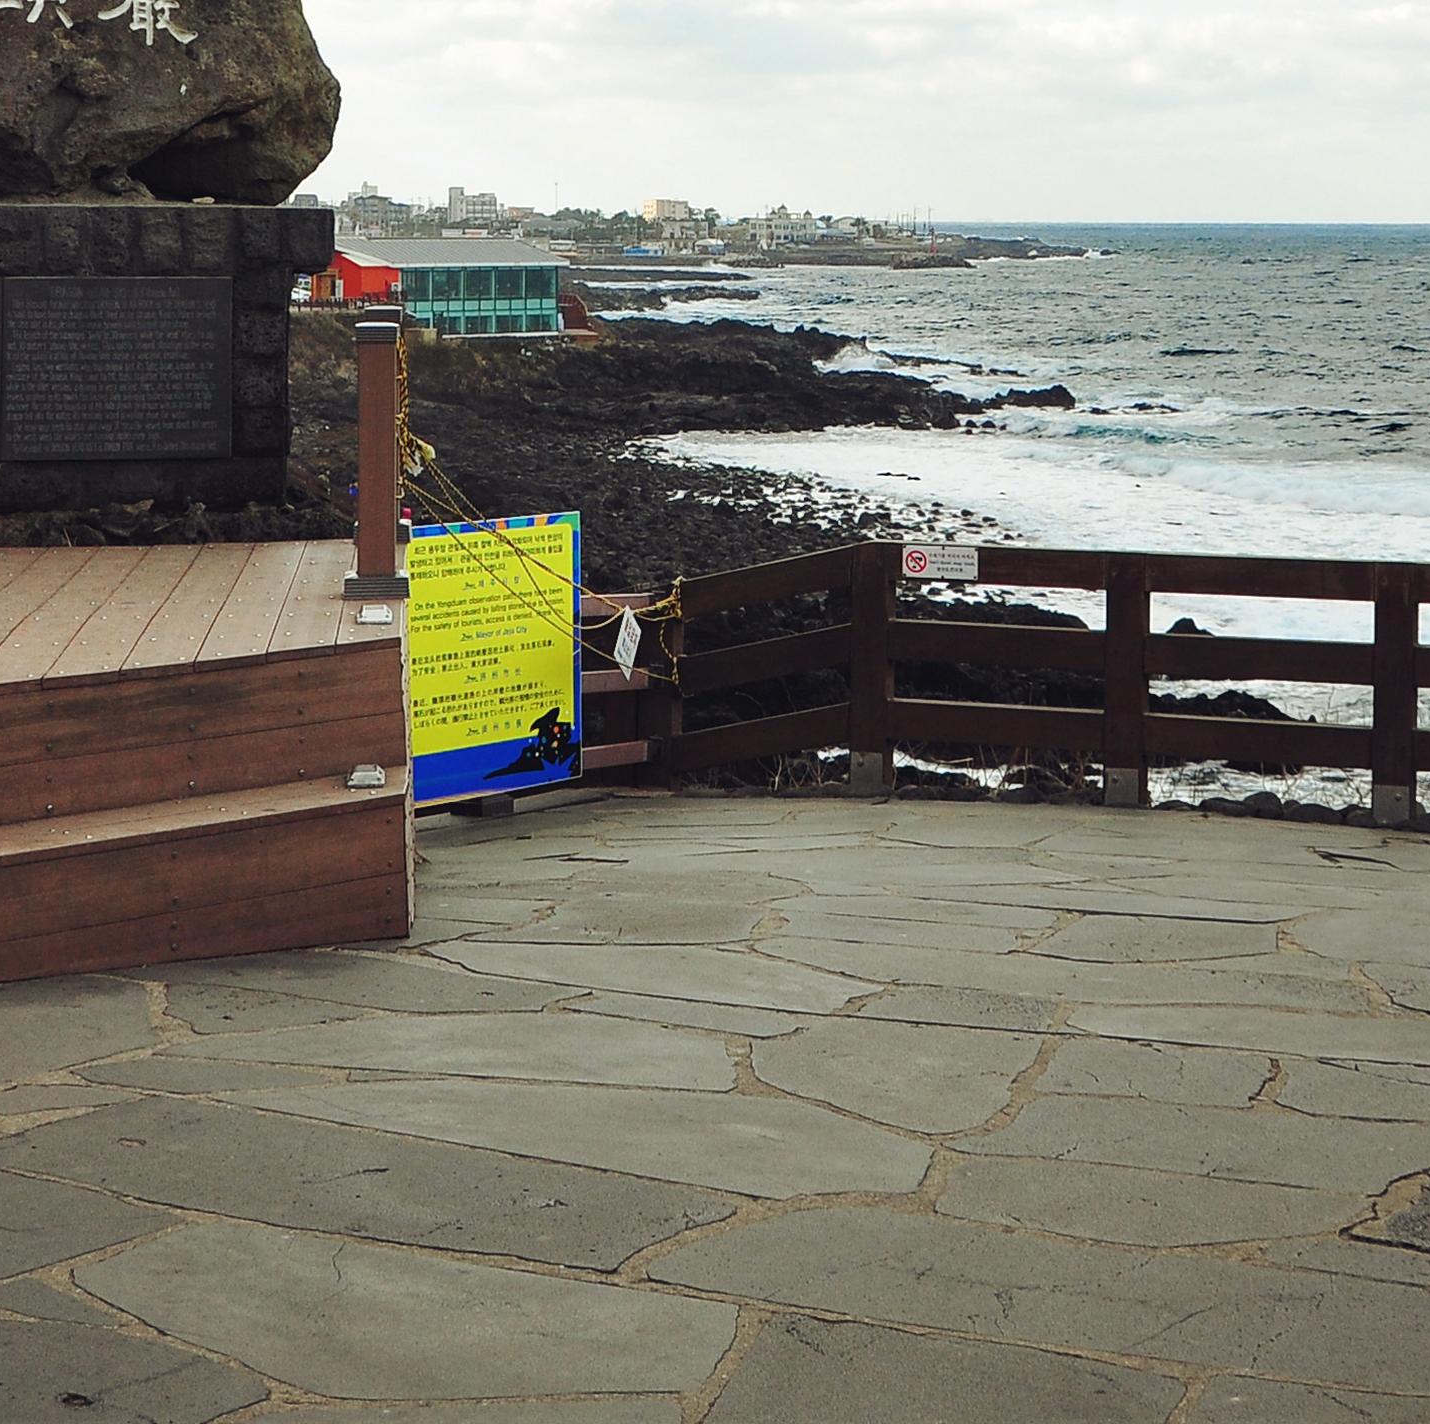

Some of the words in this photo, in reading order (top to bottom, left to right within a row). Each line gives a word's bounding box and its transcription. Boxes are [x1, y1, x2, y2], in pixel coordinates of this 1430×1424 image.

[414, 602, 423, 611] On
[425, 601, 435, 609] the
[502, 593, 517, 602] pat
[533, 589, 547, 597] hve
